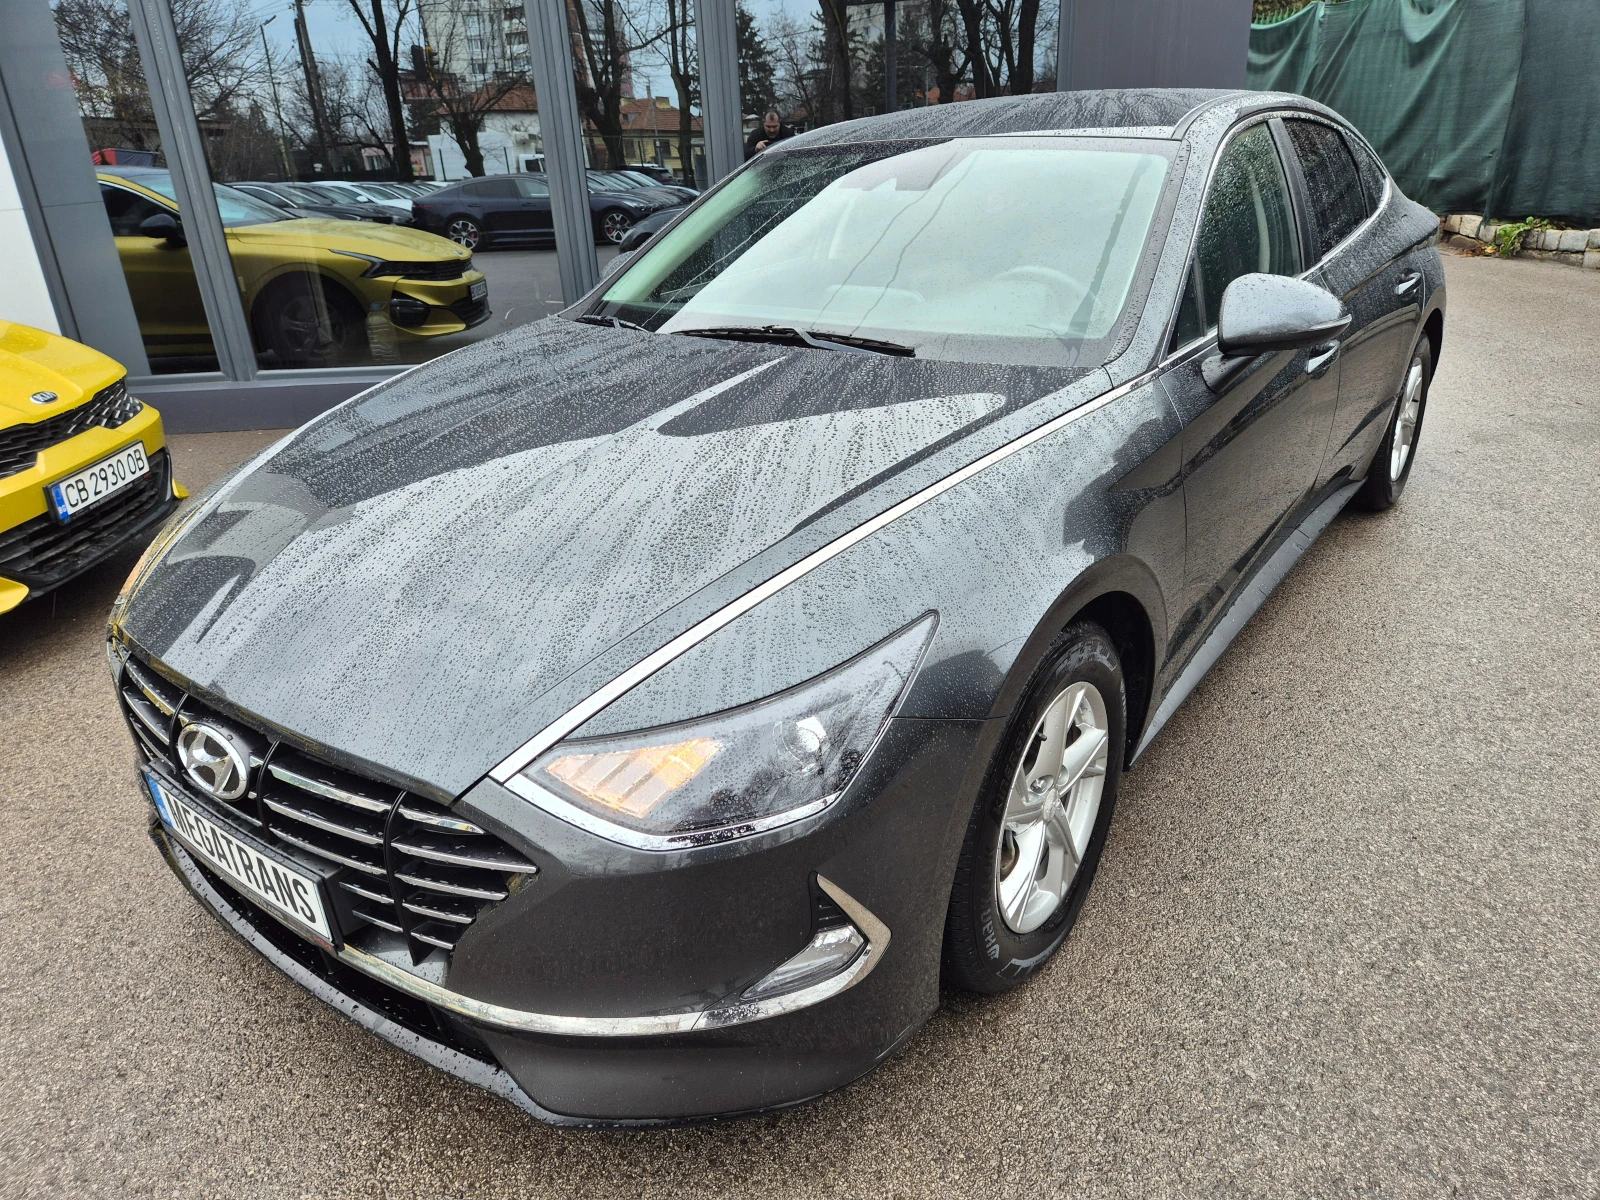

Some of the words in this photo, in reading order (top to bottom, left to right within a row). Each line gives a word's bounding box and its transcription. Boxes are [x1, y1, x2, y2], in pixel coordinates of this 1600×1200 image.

[65, 478, 89, 508] CB
[89, 458, 126, 497] 2930
[126, 448, 145, 475] OB
[163, 790, 317, 924] MEGATRANS
